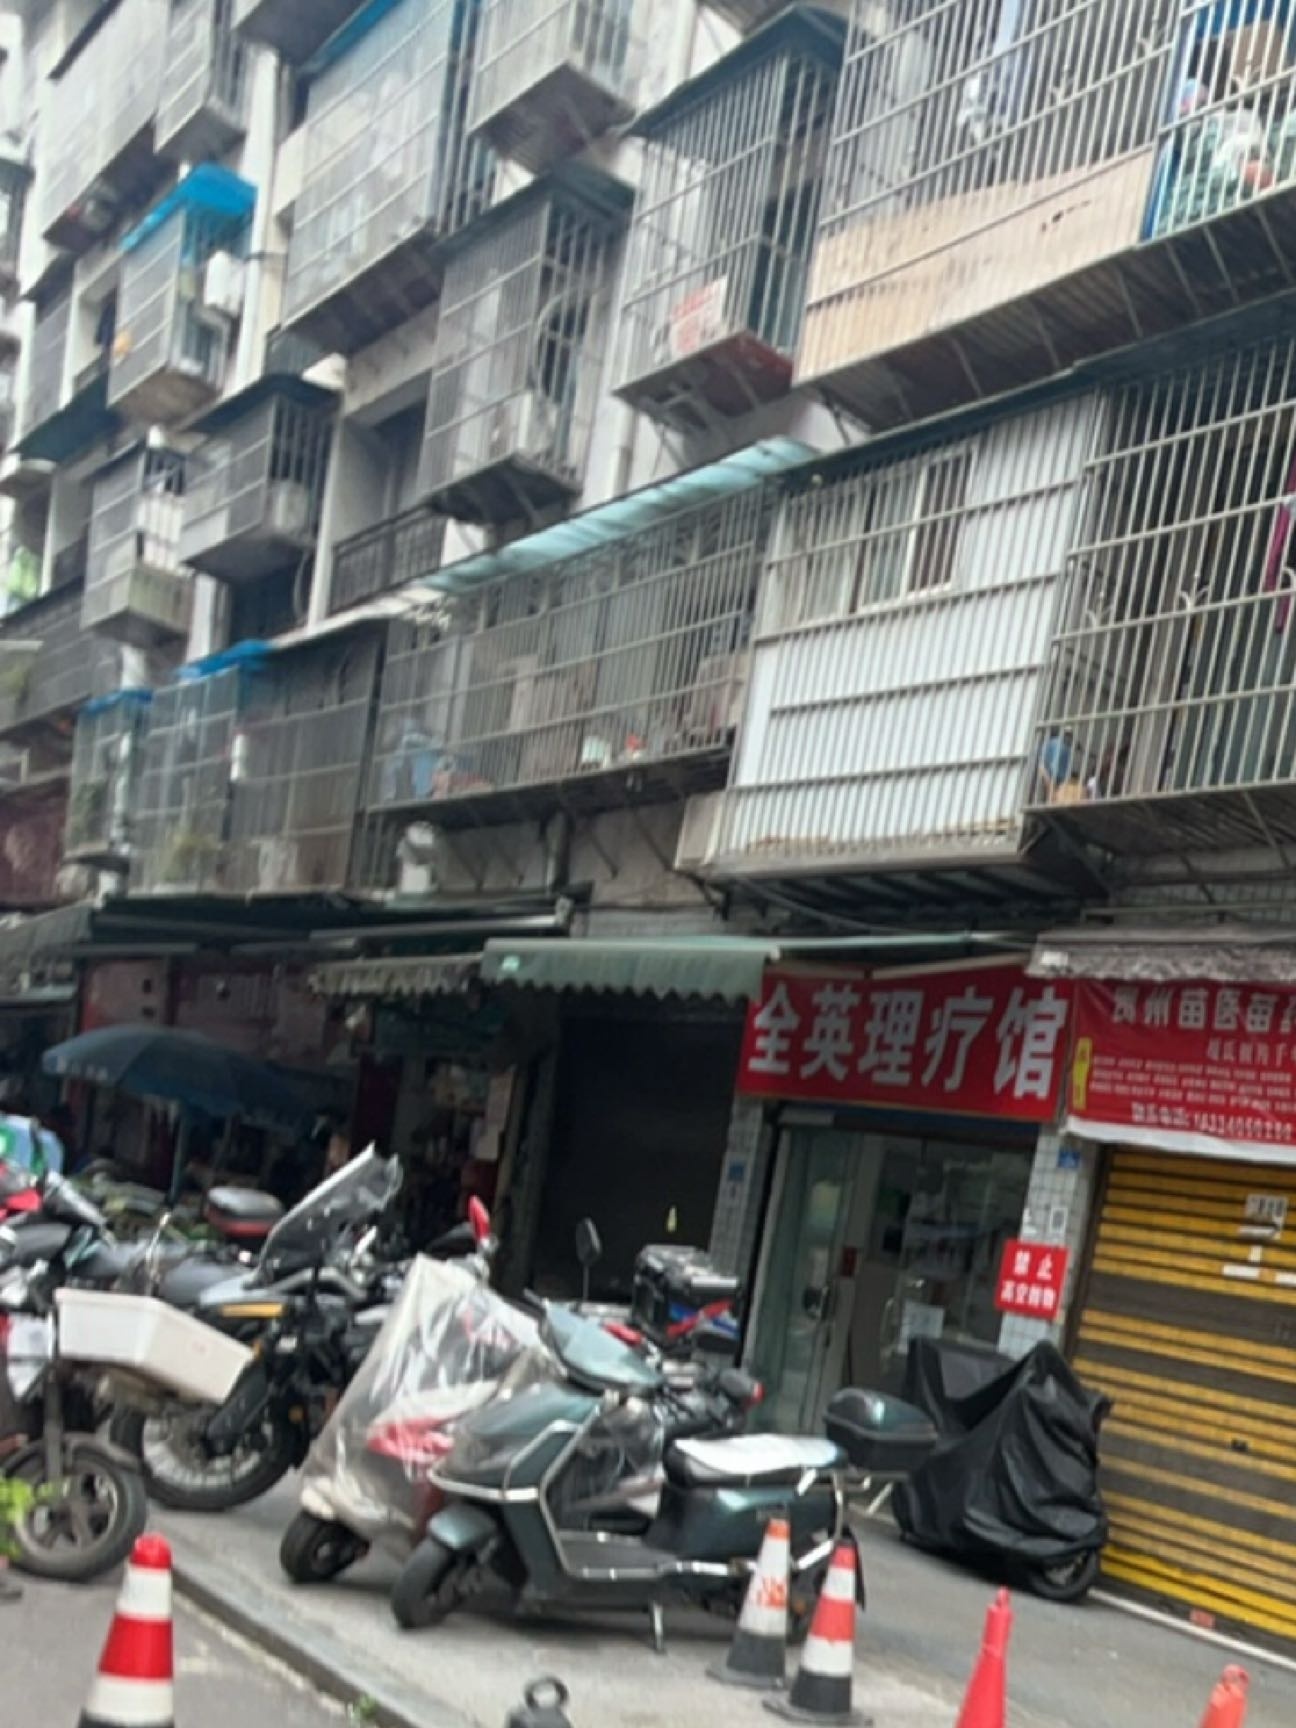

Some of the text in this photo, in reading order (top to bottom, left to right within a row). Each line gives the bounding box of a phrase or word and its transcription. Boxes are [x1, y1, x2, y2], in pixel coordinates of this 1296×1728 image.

[748, 983, 1067, 1098] 全英理疗馆
